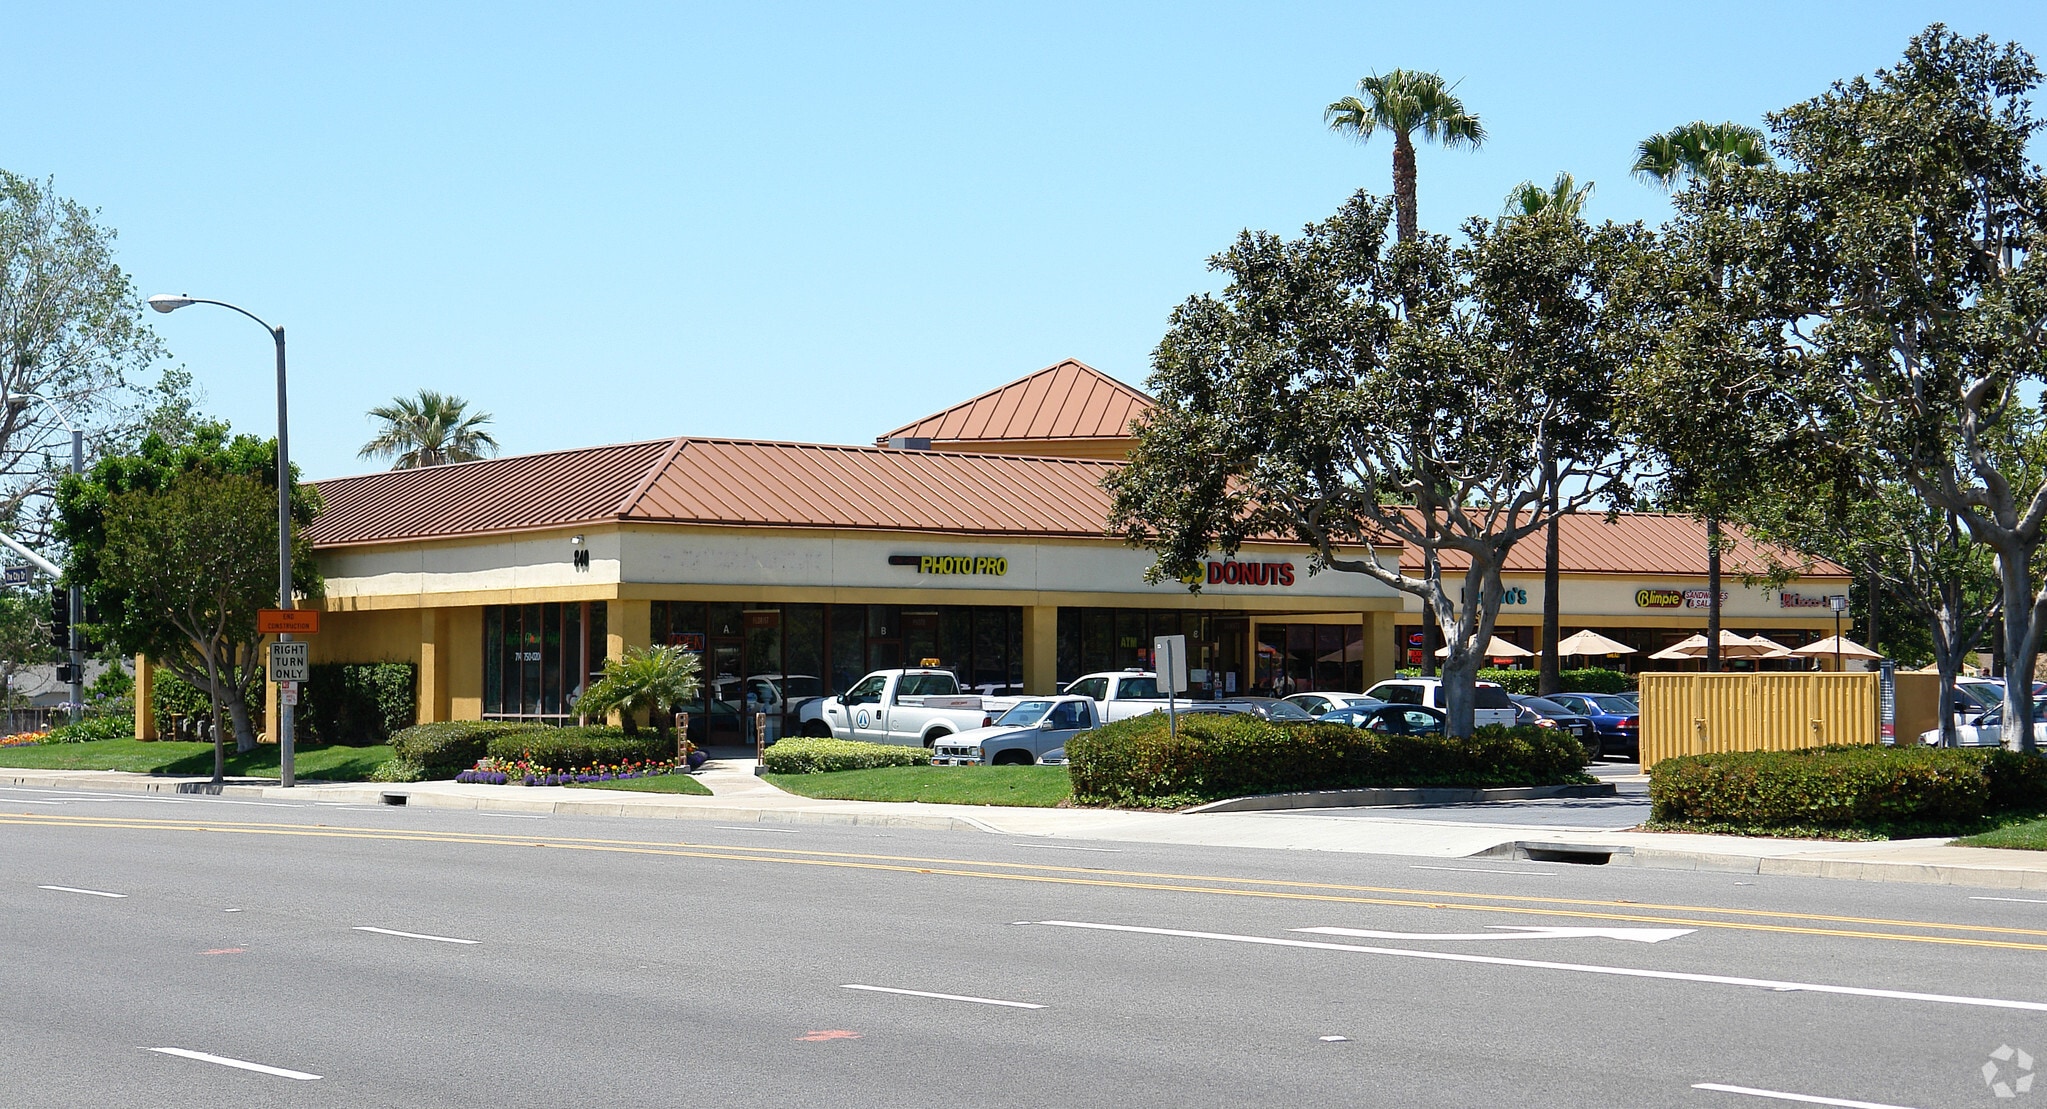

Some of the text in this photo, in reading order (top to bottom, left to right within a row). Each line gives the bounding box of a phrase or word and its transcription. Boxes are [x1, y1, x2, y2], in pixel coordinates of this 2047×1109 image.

[574, 550, 589, 567] 840
[919, 556, 973, 575] PHOTO
[975, 557, 1008, 576] PRO
[1208, 561, 1295, 587] DONUTS
[1637, 590, 1680, 607] Blimpie
[1696, 600, 1723, 608] SALS
[723, 624, 730, 634] A
[881, 627, 887, 635] B
[1120, 637, 1138, 648] ATM
[274, 645, 305, 655] RIGHT
[275, 657, 304, 667] TURN
[276, 669, 303, 679] ONLY
